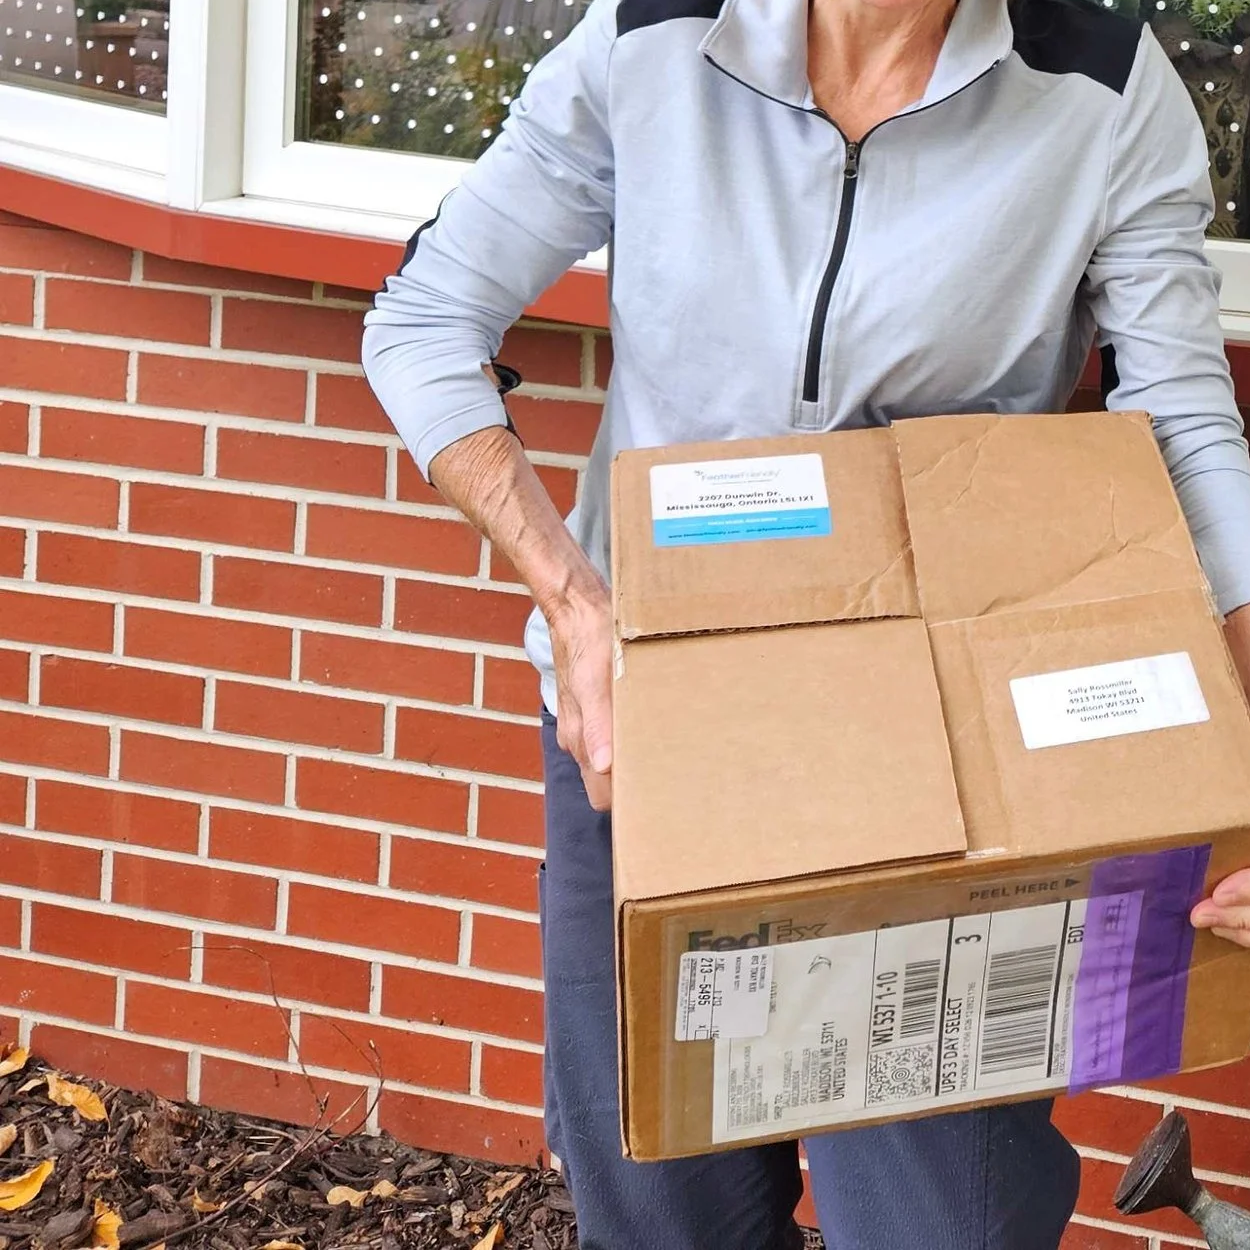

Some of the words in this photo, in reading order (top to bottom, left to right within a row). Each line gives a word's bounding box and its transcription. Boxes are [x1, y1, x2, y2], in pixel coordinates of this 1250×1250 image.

[699, 494, 722, 502] 2207
[725, 492, 764, 500] Dunwin
[738, 498, 778, 506] Ontario
[1068, 686, 1088, 695] Sally
[1069, 696, 1090, 704] 4913
[1118, 688, 1138, 696] Blvd
[1066, 704, 1104, 715] Madison
[1119, 696, 1145, 706] 53711
[1080, 711, 1109, 722] United
[1111, 708, 1138, 717] States
[970, 888, 1010, 901] PEEL
[1015, 880, 1060, 896] HERE
[955, 934, 982, 945] 3
[1068, 922, 1086, 944] EDI
[876, 971, 898, 1000] 1-10
[873, 1004, 897, 1025] 537
[945, 997, 963, 1034] SELECT
[821, 1021, 835, 1044] 53711
[872, 1026, 894, 1048] WI
[820, 1047, 833, 1060] WI
[834, 1038, 848, 1065] STATES
[943, 1037, 960, 1059] DAY
[943, 1061, 958, 1071] 3
[818, 1061, 832, 1103] MADISON
[832, 1067, 846, 1100] UNITED
[941, 1070, 956, 1093] UPS
